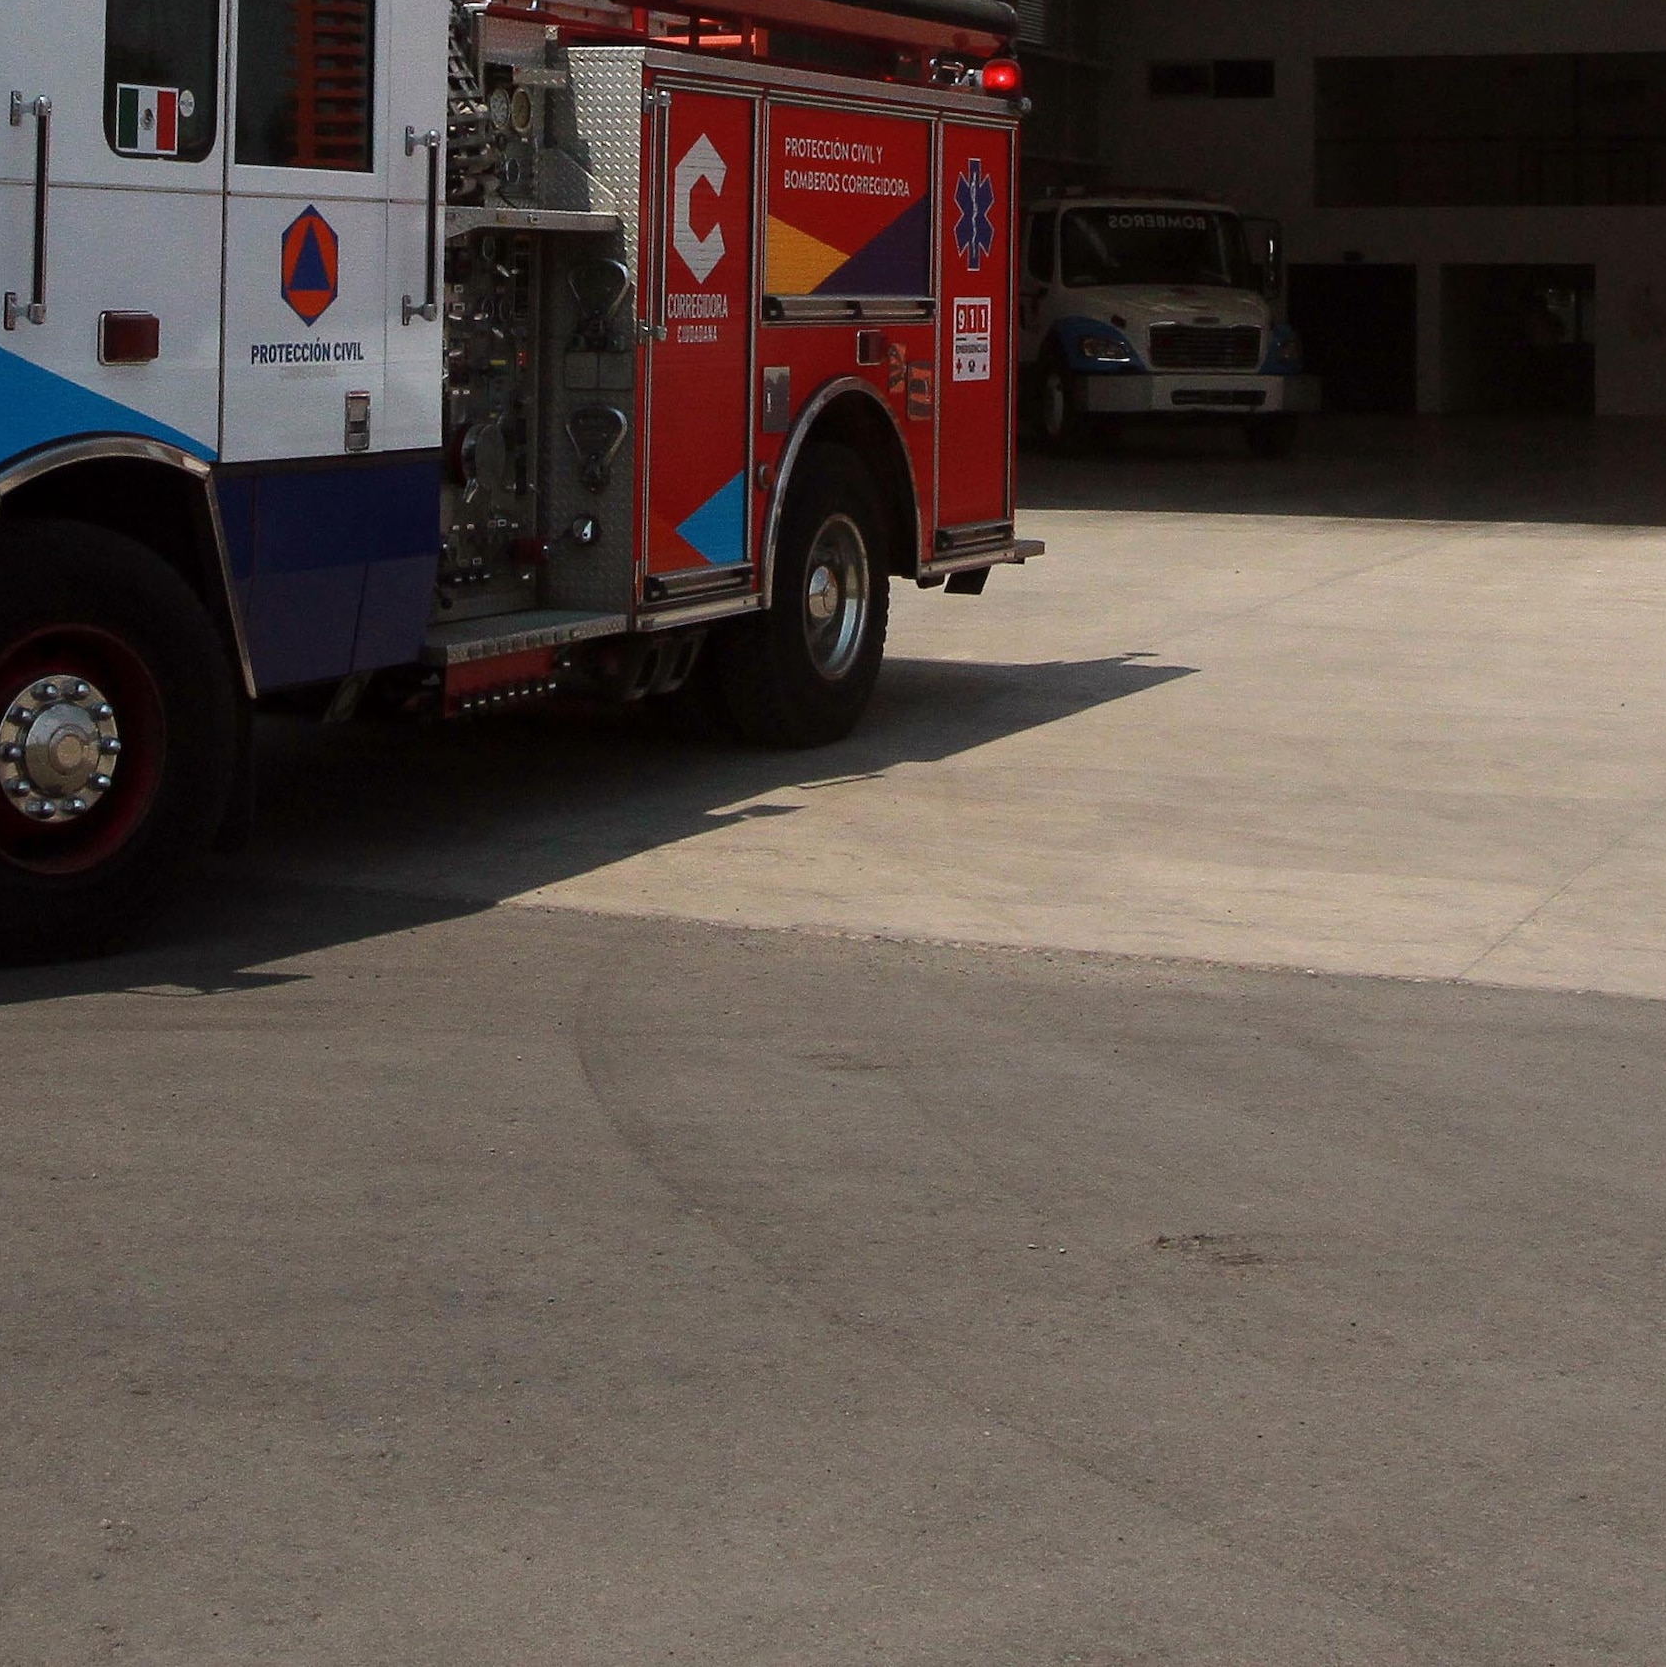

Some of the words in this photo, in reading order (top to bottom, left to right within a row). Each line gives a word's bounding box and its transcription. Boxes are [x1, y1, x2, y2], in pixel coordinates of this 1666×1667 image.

[784, 136, 850, 161] PROTECCIÓN
[851, 143, 875, 164] CIVIL
[876, 146, 884, 165] Y
[784, 169, 840, 192] BOMBEROS
[841, 174, 911, 197] CORREGIDORA
[667, 293, 729, 319] CORREGIDORA
[250, 337, 331, 365] PROTECCIÓN
[333, 341, 365, 361] CIVIL
